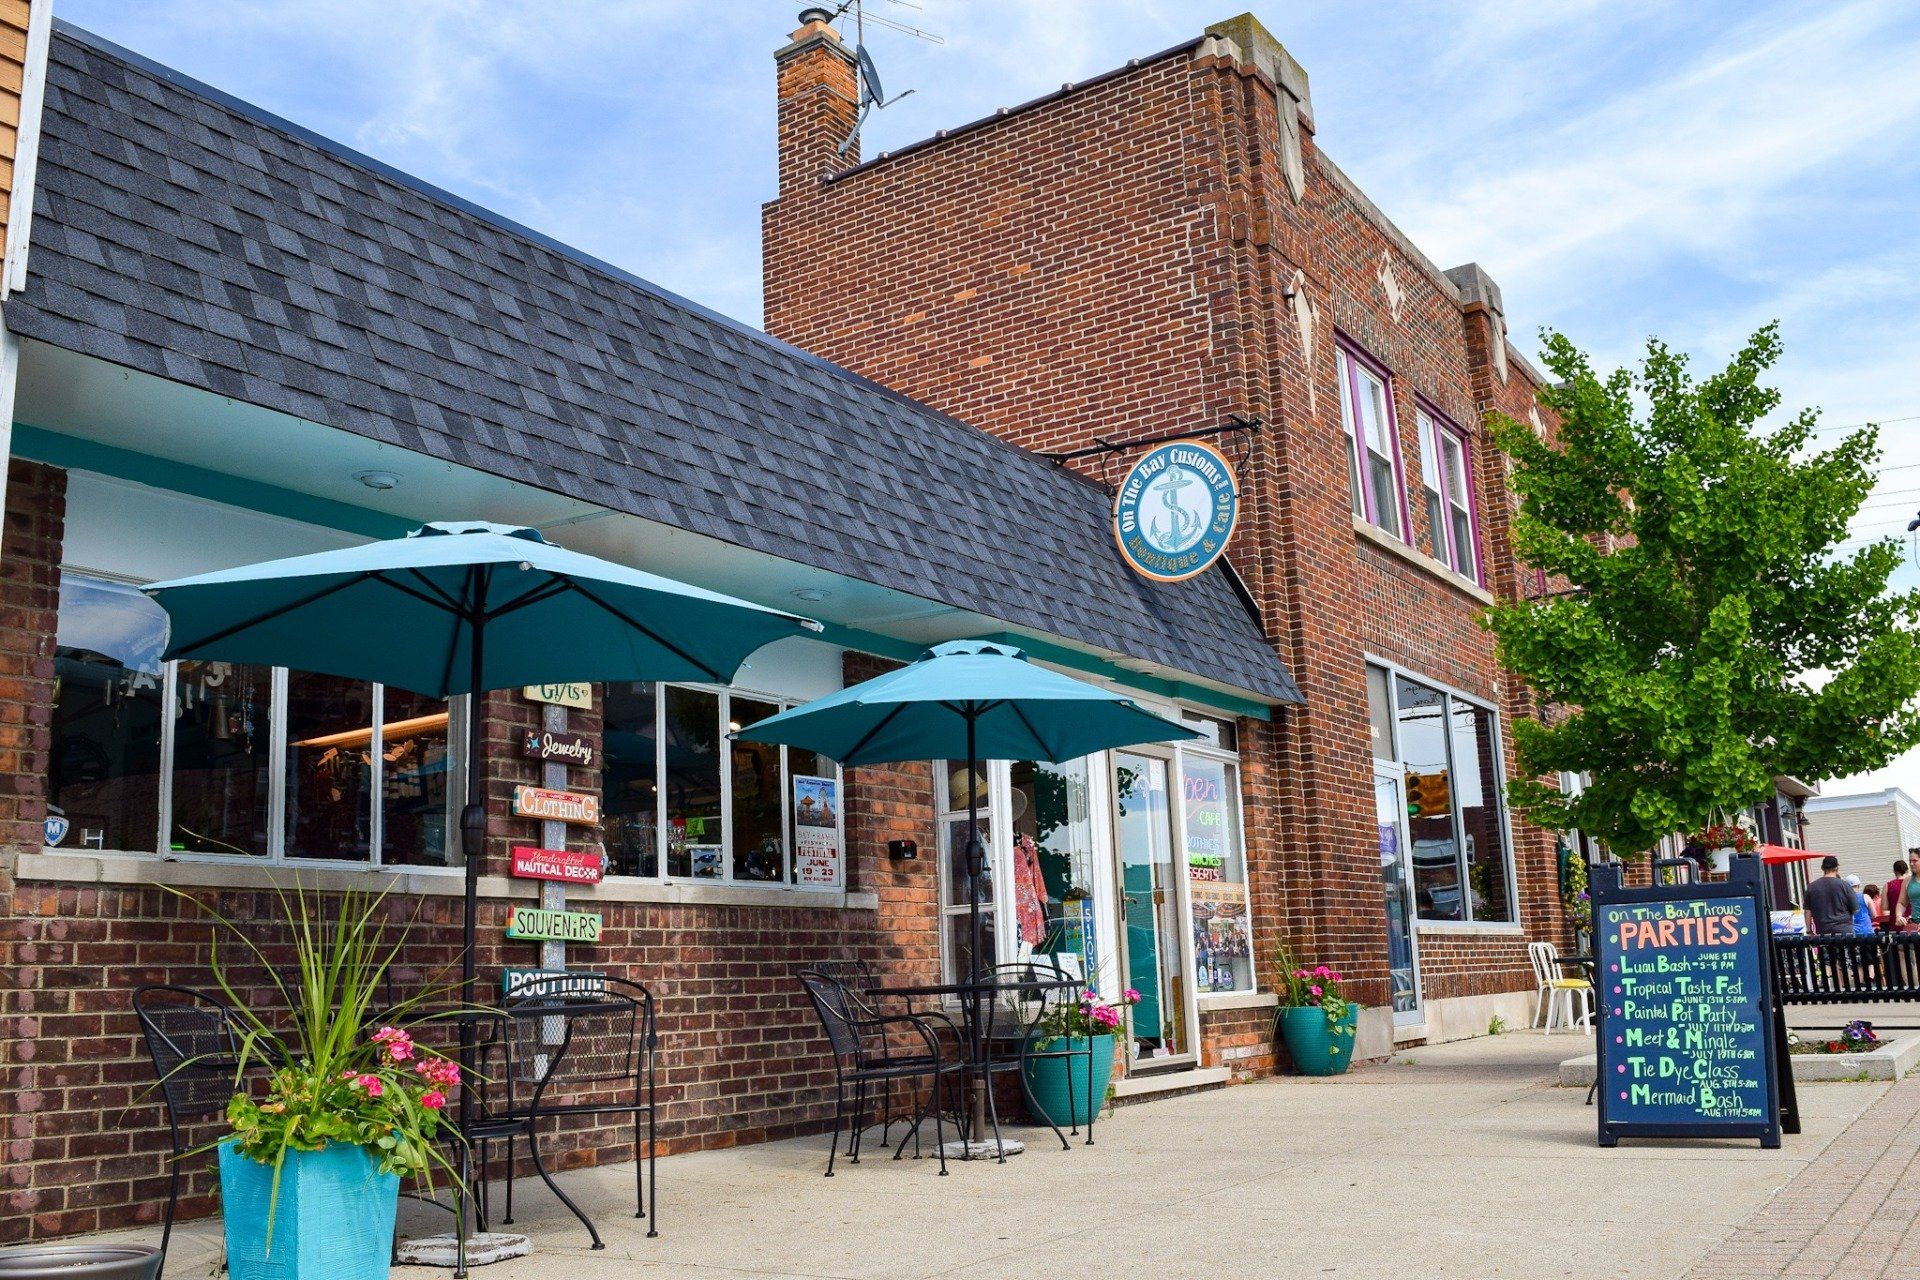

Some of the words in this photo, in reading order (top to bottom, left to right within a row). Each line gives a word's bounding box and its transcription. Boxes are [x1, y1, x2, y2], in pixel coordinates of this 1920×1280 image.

[1138, 454, 1165, 480] Bay
[1170, 449, 1221, 485] Customs
[1122, 478, 1143, 506] The
[1122, 511, 1136, 532] On
[541, 733, 592, 764] Jewelry
[1183, 774, 1218, 802] pen
[521, 788, 594, 820] CLOTHING
[517, 860, 562, 876] NAUTICAL
[565, 865, 597, 879] DECOR
[802, 867, 812, 875] 19
[822, 868, 833, 876] 23
[807, 859, 829, 867] JUNE
[1608, 911, 1628, 922] On
[1632, 908, 1662, 920] The
[1665, 905, 1690, 919] Bay
[1689, 902, 1742, 918] Throws
[1620, 915, 1739, 950] PARTIES
[1620, 955, 1655, 974] Luau
[1698, 953, 1719, 961] JUNE
[1720, 961, 1735, 970] PM
[1621, 978, 1672, 1000] Tropical
[1675, 977, 1713, 995] Taste
[1716, 975, 1743, 995] Fest
[1706, 996, 1724, 1004] 13TH
[1624, 1000, 1668, 1020] Painted
[1672, 1002, 1694, 1021] Pot
[1699, 1003, 1736, 1028] Party
[1625, 1027, 1664, 1047] Meet
[1667, 1027, 1680, 1049] &
[1685, 1030, 1738, 1052] Mingle
[1627, 1057, 1656, 1078] Tie
[1660, 1057, 1693, 1085] Dye
[1694, 1059, 1740, 1079] Class
[1631, 1083, 1697, 1105] Mermaid
[1701, 1088, 1743, 1109] Bash
